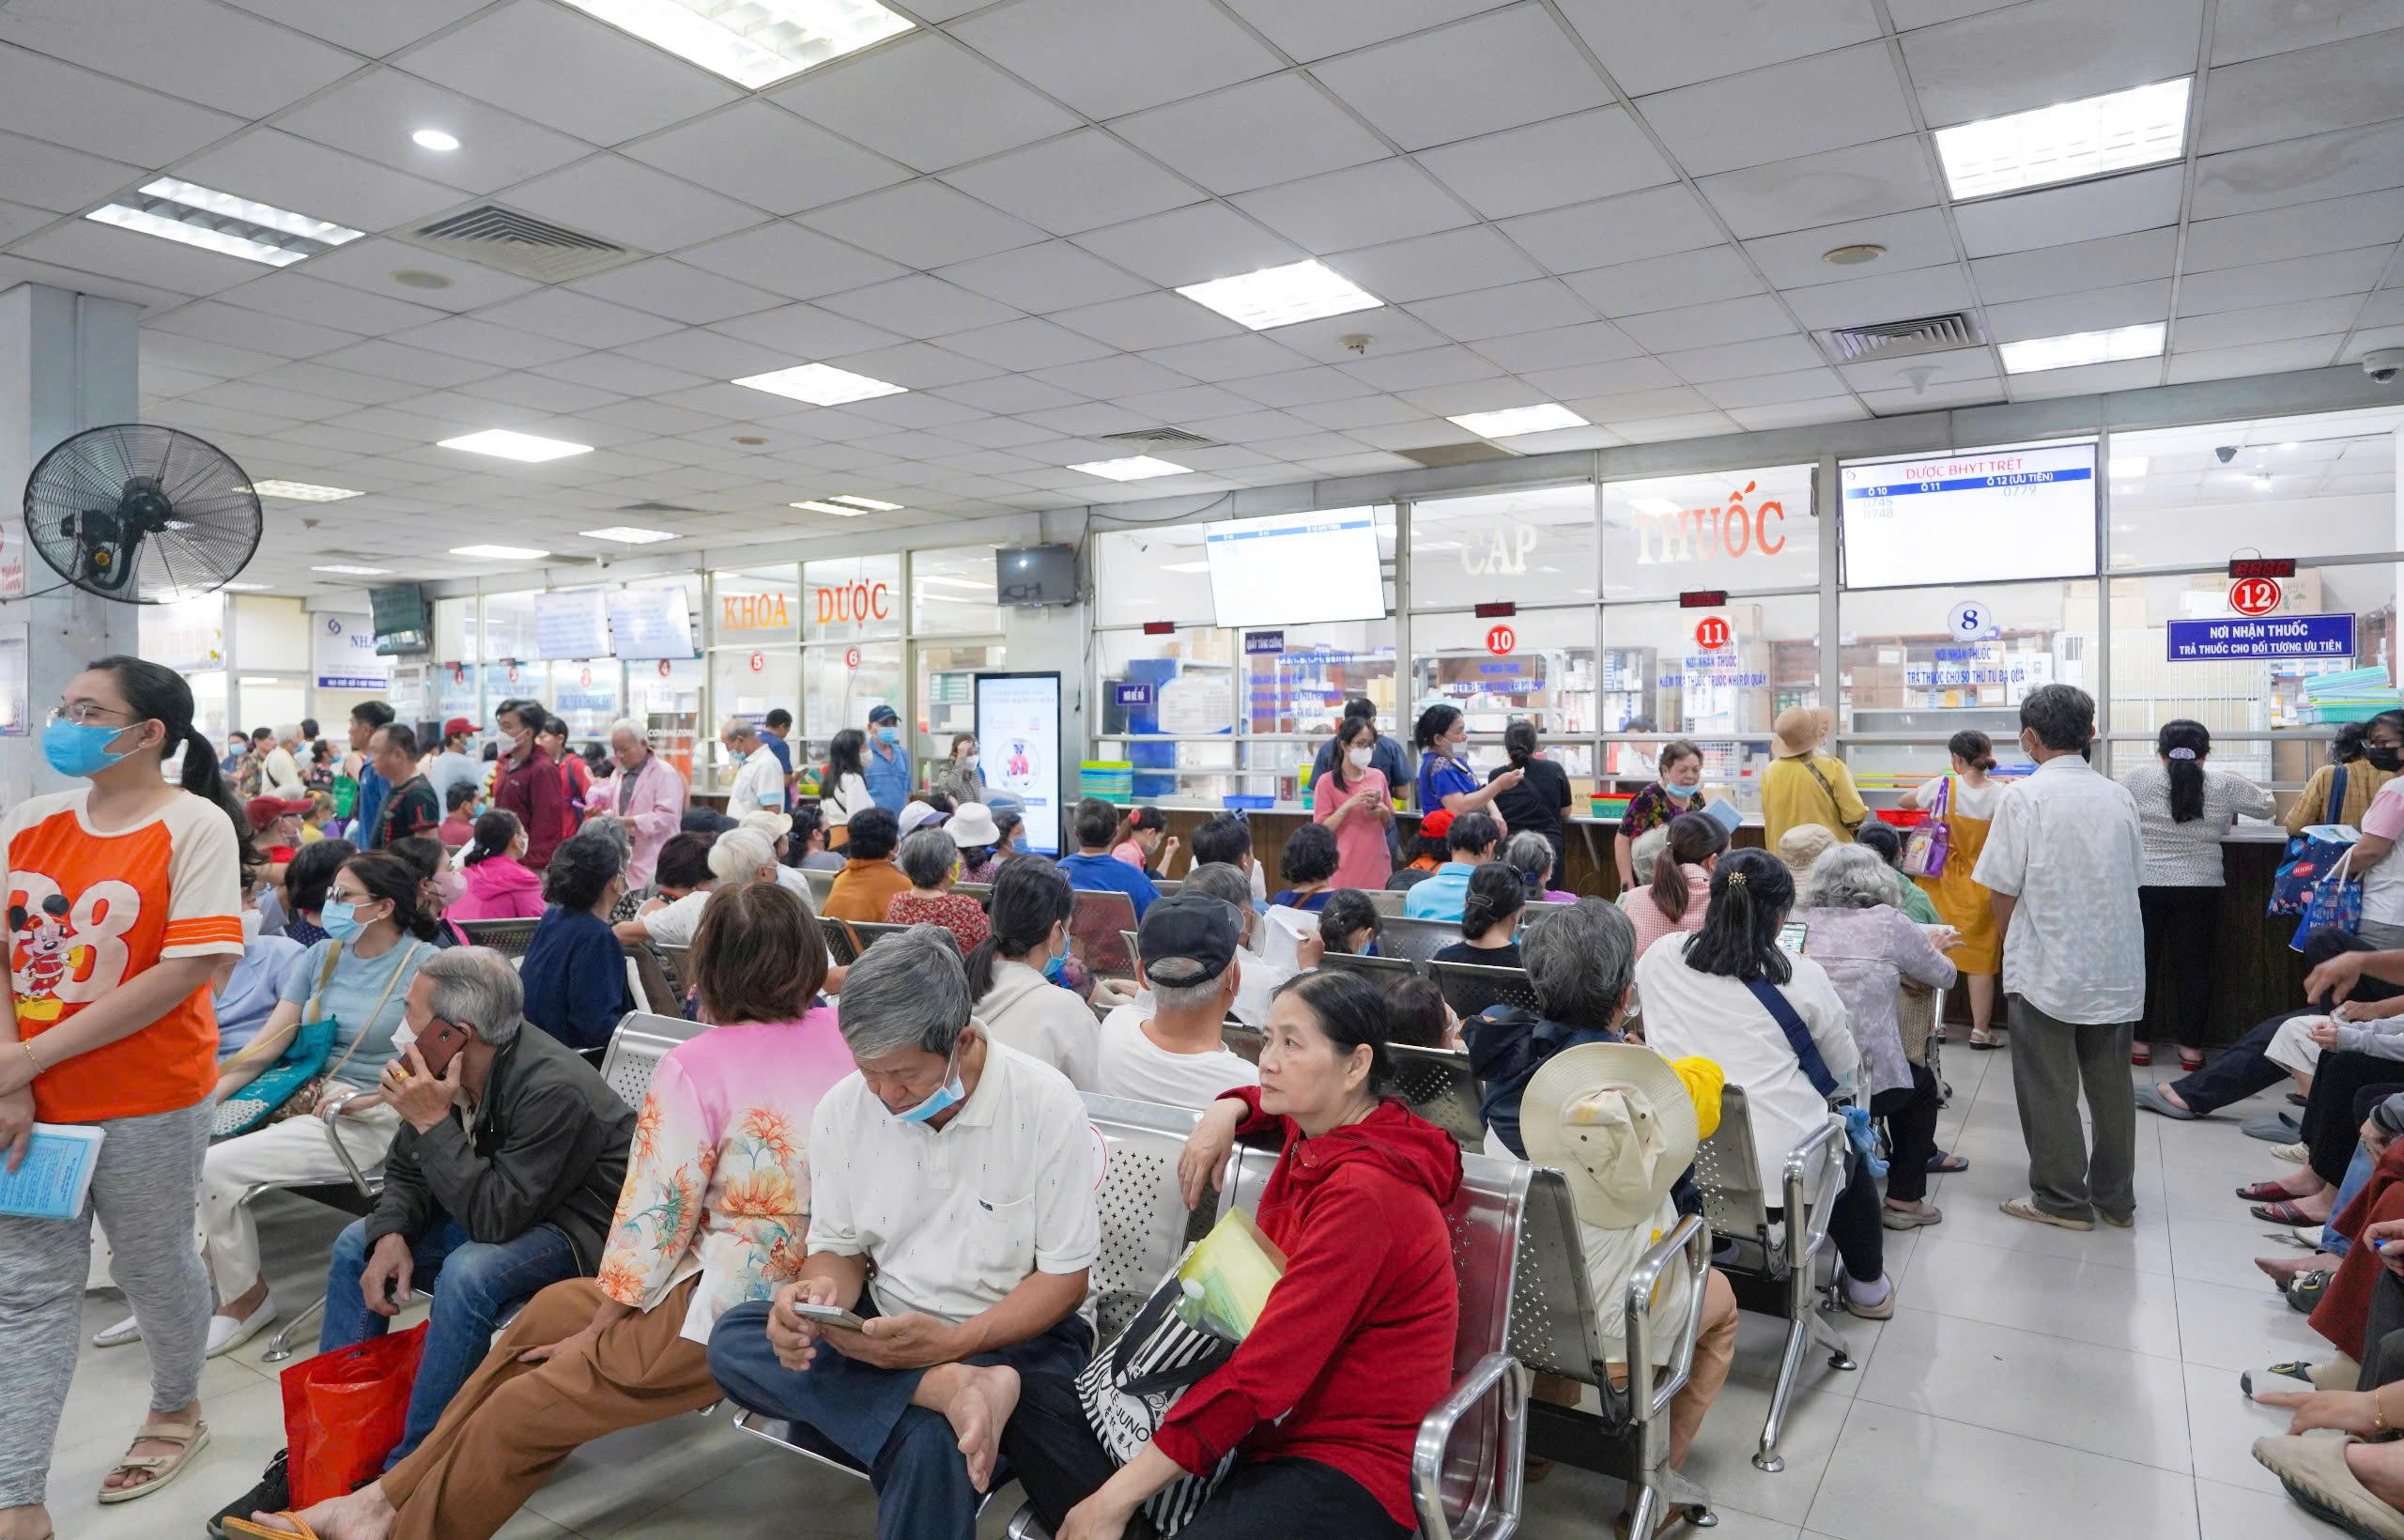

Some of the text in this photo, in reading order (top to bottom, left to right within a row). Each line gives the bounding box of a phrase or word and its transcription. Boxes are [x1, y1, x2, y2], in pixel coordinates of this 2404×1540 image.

[1906, 457, 2025, 481] DƯỢC BHYT TRỆT
[1931, 483, 1940, 492] 11
[1996, 476, 2008, 485] 12
[1876, 486, 1888, 496] 10
[2003, 485, 2037, 497] 0779
[1633, 480, 1786, 564] THUỐC
[722, 593, 790, 630] KHOA
[816, 578, 889, 630] DƯỢC
[2241, 583, 2273, 609] 12
[1961, 609, 1979, 630] 8
[1703, 624, 1724, 644] 11
[2210, 620, 2309, 640] NƠI NHẬN THUỐC
[1491, 630, 1512, 651] 10
[2179, 638, 2343, 655] TRẢ THUỐC CHO ĐỐI TƯỢNG ƯU TIÊN
